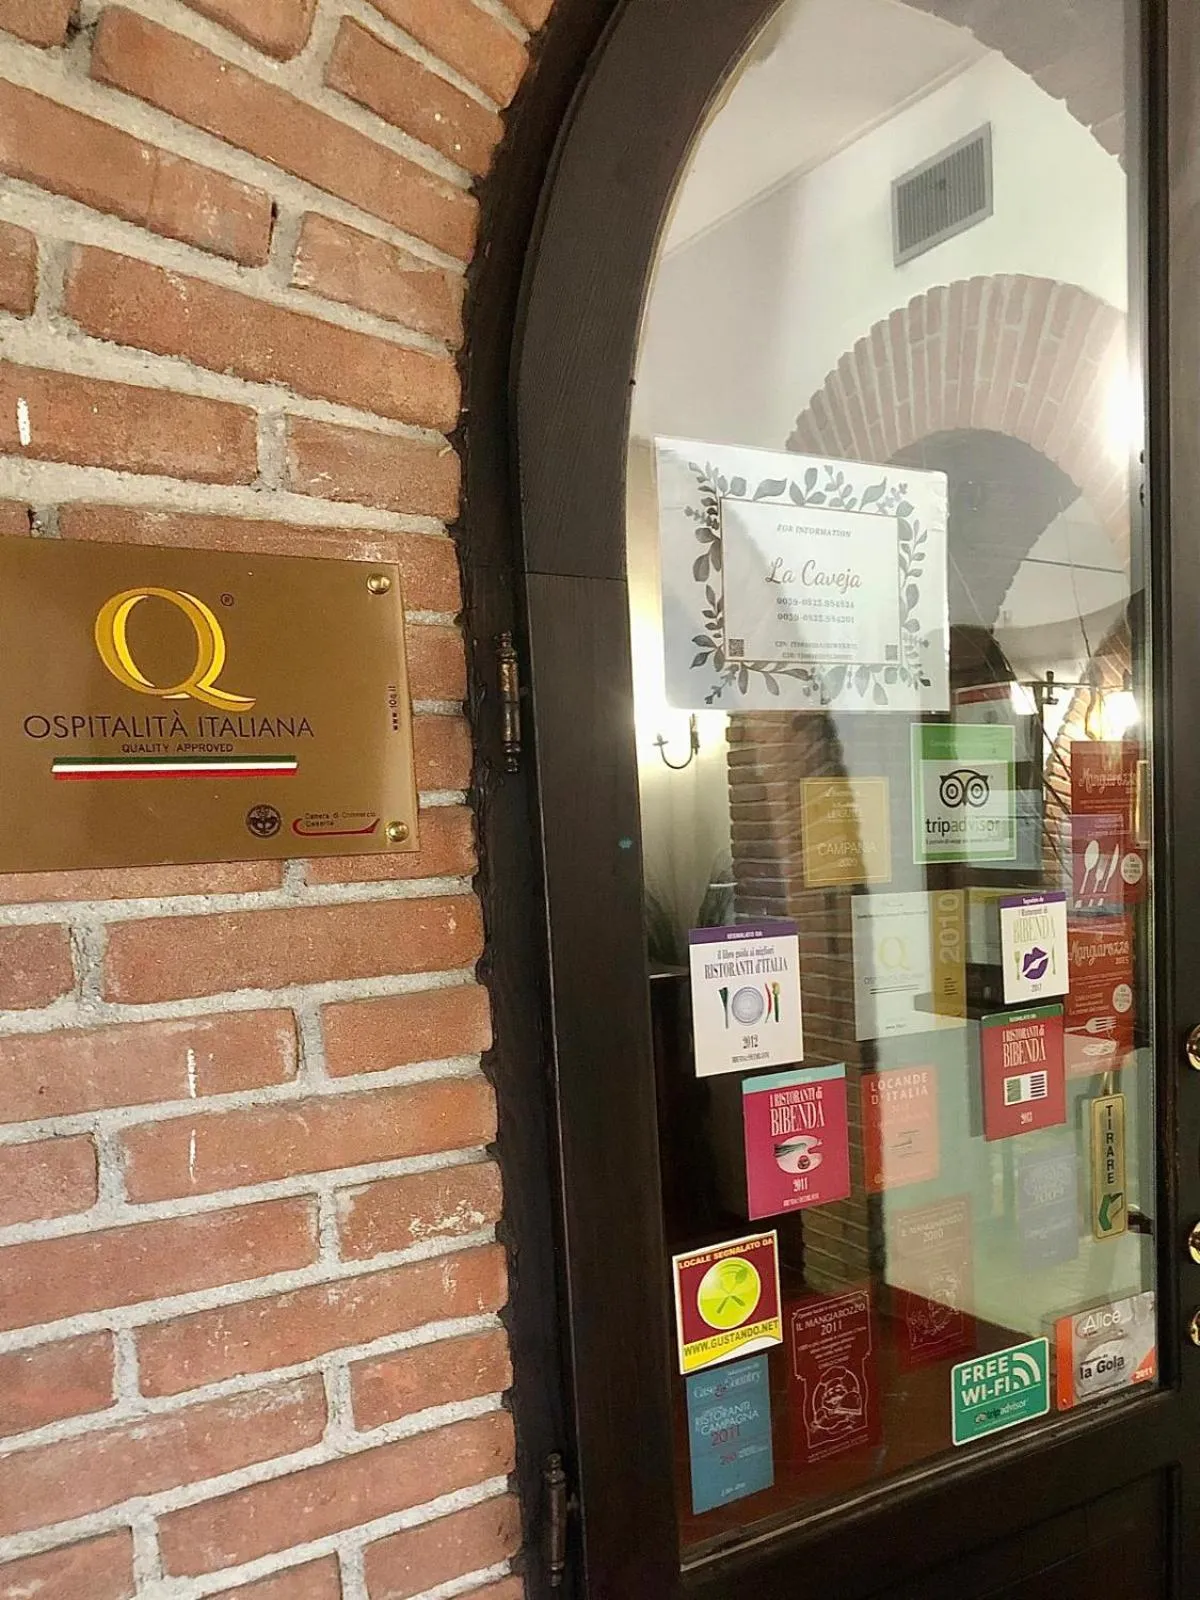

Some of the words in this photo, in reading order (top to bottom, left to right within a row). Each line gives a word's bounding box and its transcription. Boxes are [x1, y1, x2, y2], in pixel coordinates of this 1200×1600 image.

[777, 524, 793, 533] FOR
[796, 526, 851, 537] INFORMATION
[765, 557, 796, 584] La
[801, 559, 862, 594] Caveja
[95, 587, 256, 712] Q
[24, 709, 188, 738] OSPITALITÀ
[199, 717, 315, 738] ITALIANA
[121, 743, 169, 754] QUALITY
[176, 743, 234, 753] APPROVED
[925, 817, 1000, 837] tripadvisor
[937, 893, 960, 964] 2010
[1013, 915, 1056, 943] BIBENDA
[705, 960, 753, 979] RISTORANTI
[1003, 1038, 1046, 1067] BIBENDA
[871, 1072, 928, 1091] LOCANDE
[871, 1086, 928, 1104] D'ITALIA
[774, 1087, 815, 1106] RISTORANTI
[770, 1101, 825, 1136] BIBENDA
[1106, 1105, 1114, 1184] TIRARE
[680, 1255, 712, 1269] LOCALE
[713, 1241, 761, 1260] SEGNALATO
[796, 1323, 804, 1331] IL
[805, 1303, 865, 1328] MANGIAROZZO
[821, 1320, 842, 1336] 2011
[1084, 1308, 1121, 1331] Alice
[684, 1320, 778, 1356] WWW.GUSTANDO.NET
[961, 1354, 1009, 1386] FREE
[1080, 1367, 1092, 1379] la
[1097, 1356, 1124, 1373] Gola
[961, 1376, 1010, 1407] WI-FI
[701, 1409, 759, 1435] CAMPAGNA
[988, 1400, 1026, 1419] tripadvisor
[711, 1426, 740, 1446] 2011
